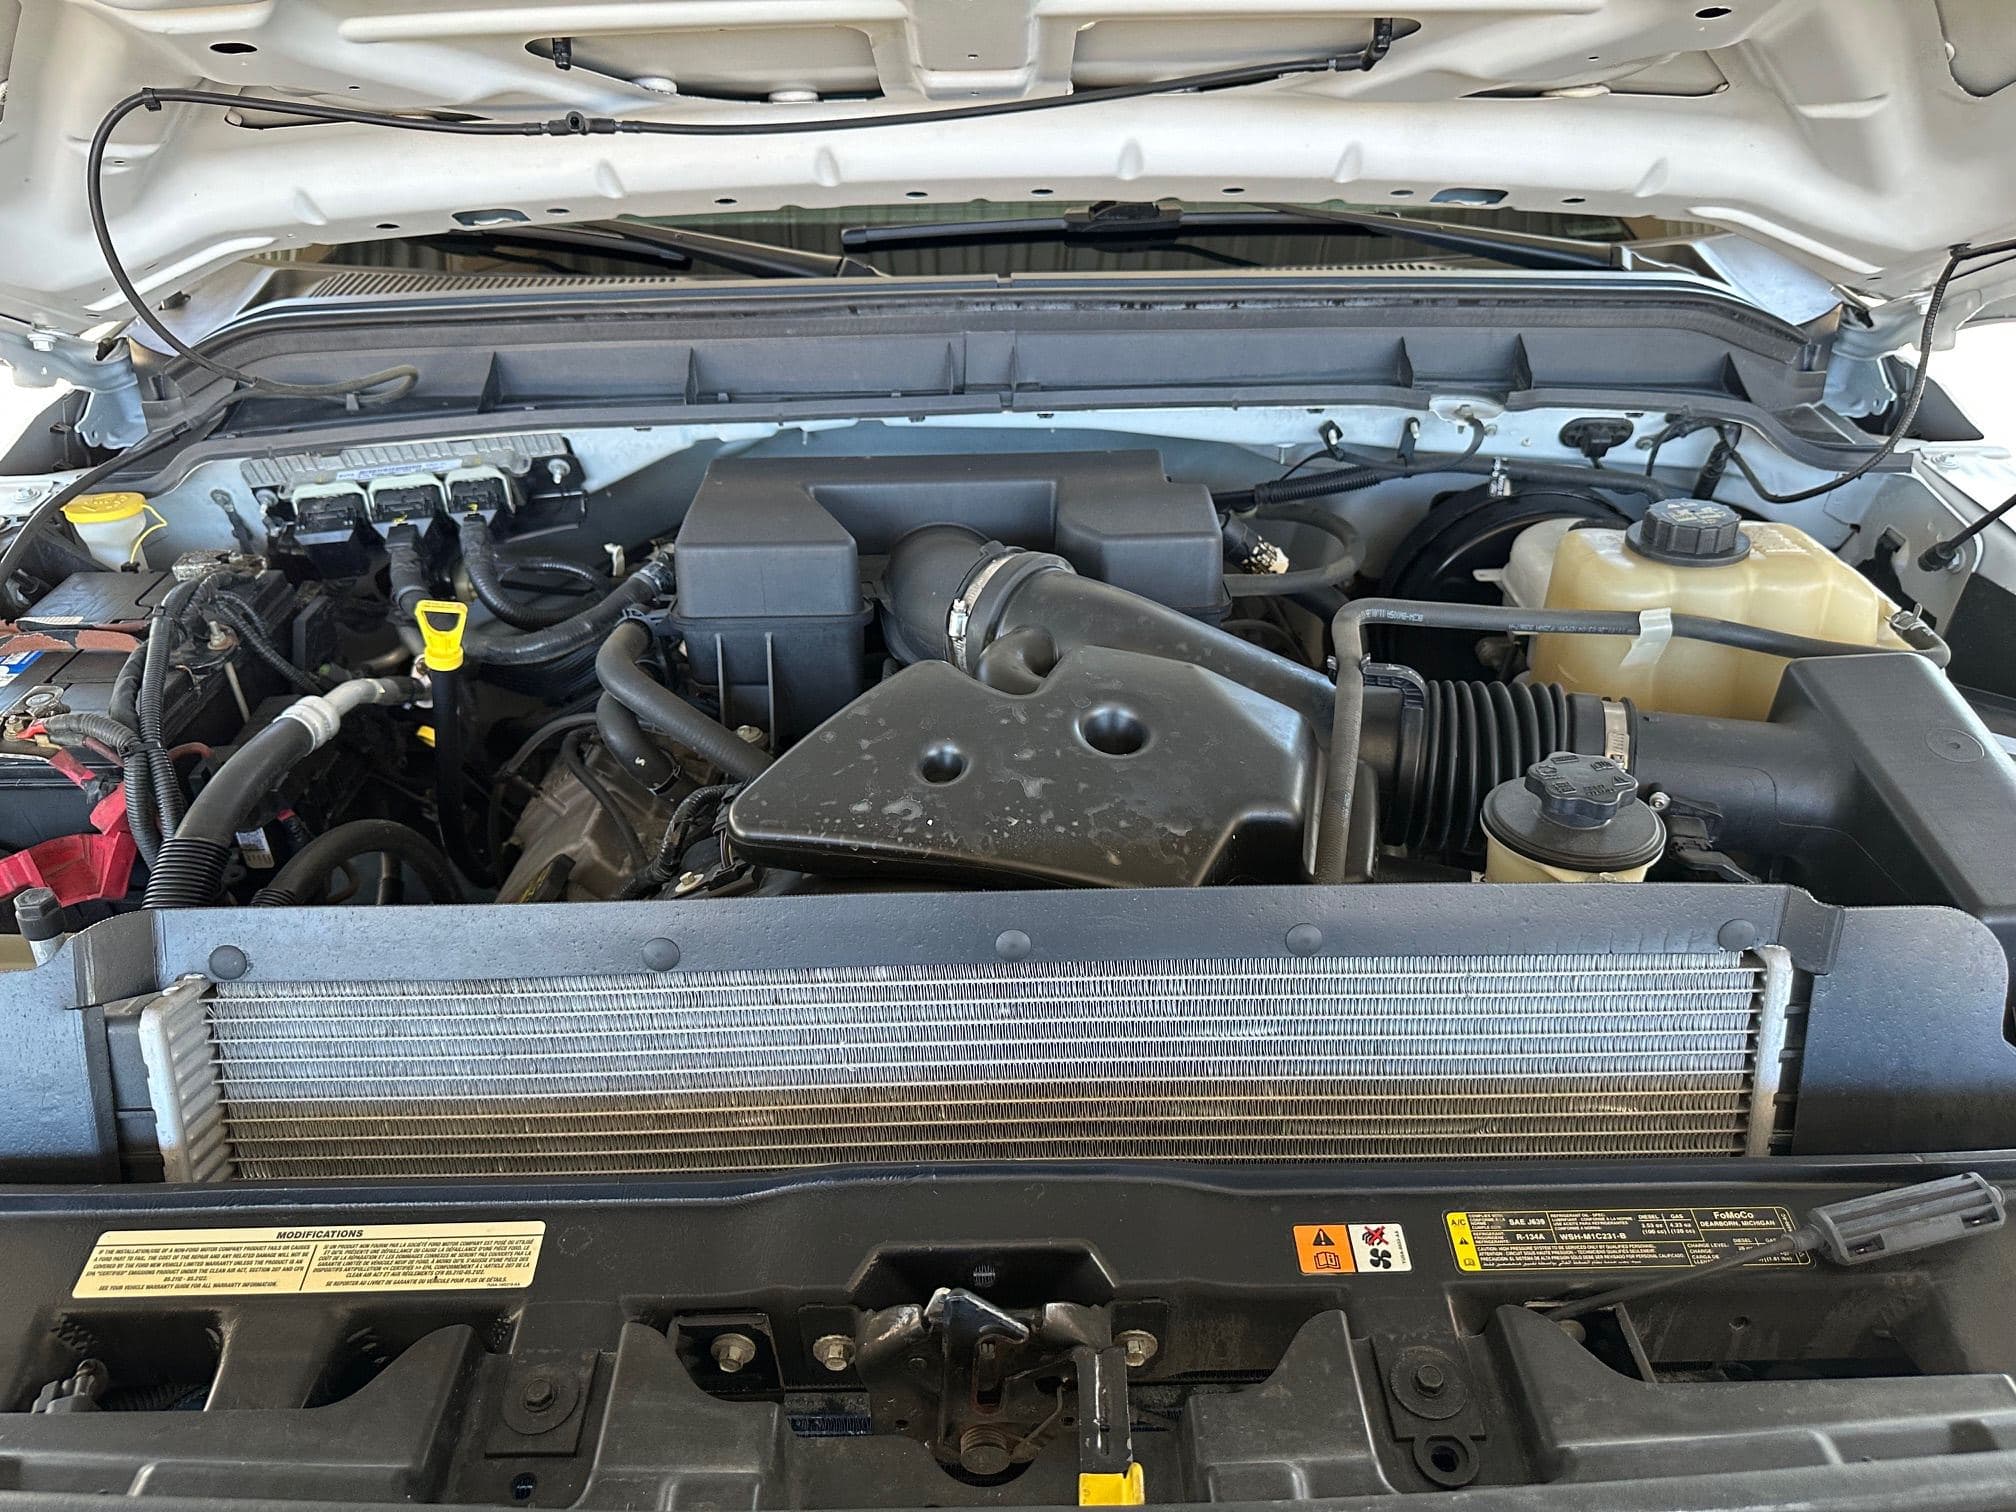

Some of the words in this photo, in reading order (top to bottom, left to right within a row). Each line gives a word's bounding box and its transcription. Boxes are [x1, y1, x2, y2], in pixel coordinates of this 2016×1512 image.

[1713, 1210, 1754, 1219] FoMoCo
[1452, 1218, 1466, 1227] A/C
[276, 1230, 364, 1239] MODIFICATIONS
